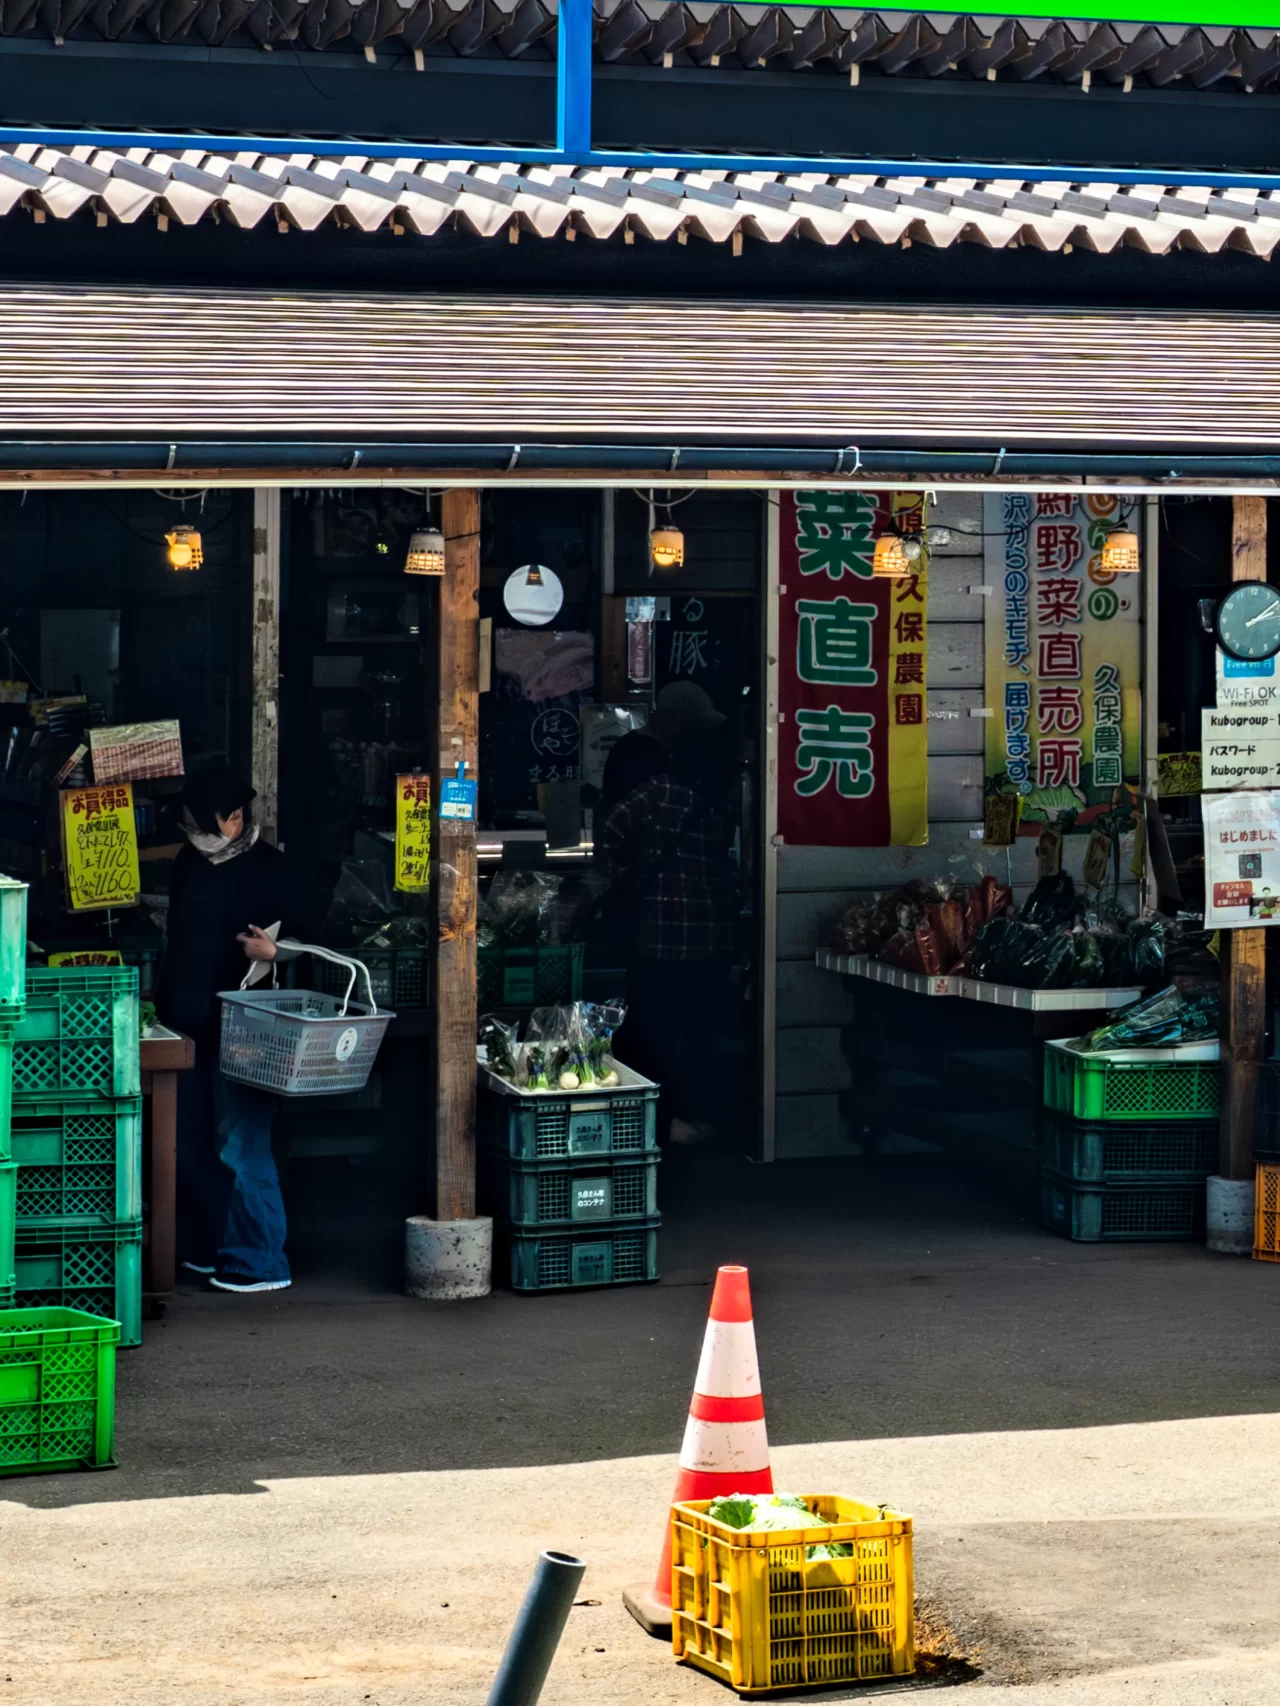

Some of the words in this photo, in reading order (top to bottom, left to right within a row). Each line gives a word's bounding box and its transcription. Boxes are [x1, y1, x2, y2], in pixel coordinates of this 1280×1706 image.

[895, 573, 924, 726] 久保農園
[1223, 688, 1255, 699] Wi-Fi
[1257, 686, 1277, 698] OK
[1231, 699, 1247, 708] Free
[1249, 699, 1269, 707] SPOT
[1093, 662, 1122, 786] 久保農園
[1210, 745, 1256, 756] パスワード
[71, 788, 130, 821] お買得品
[1220, 829, 1278, 843] はじめました
[577, 1199, 605, 1207] のコンテナ
